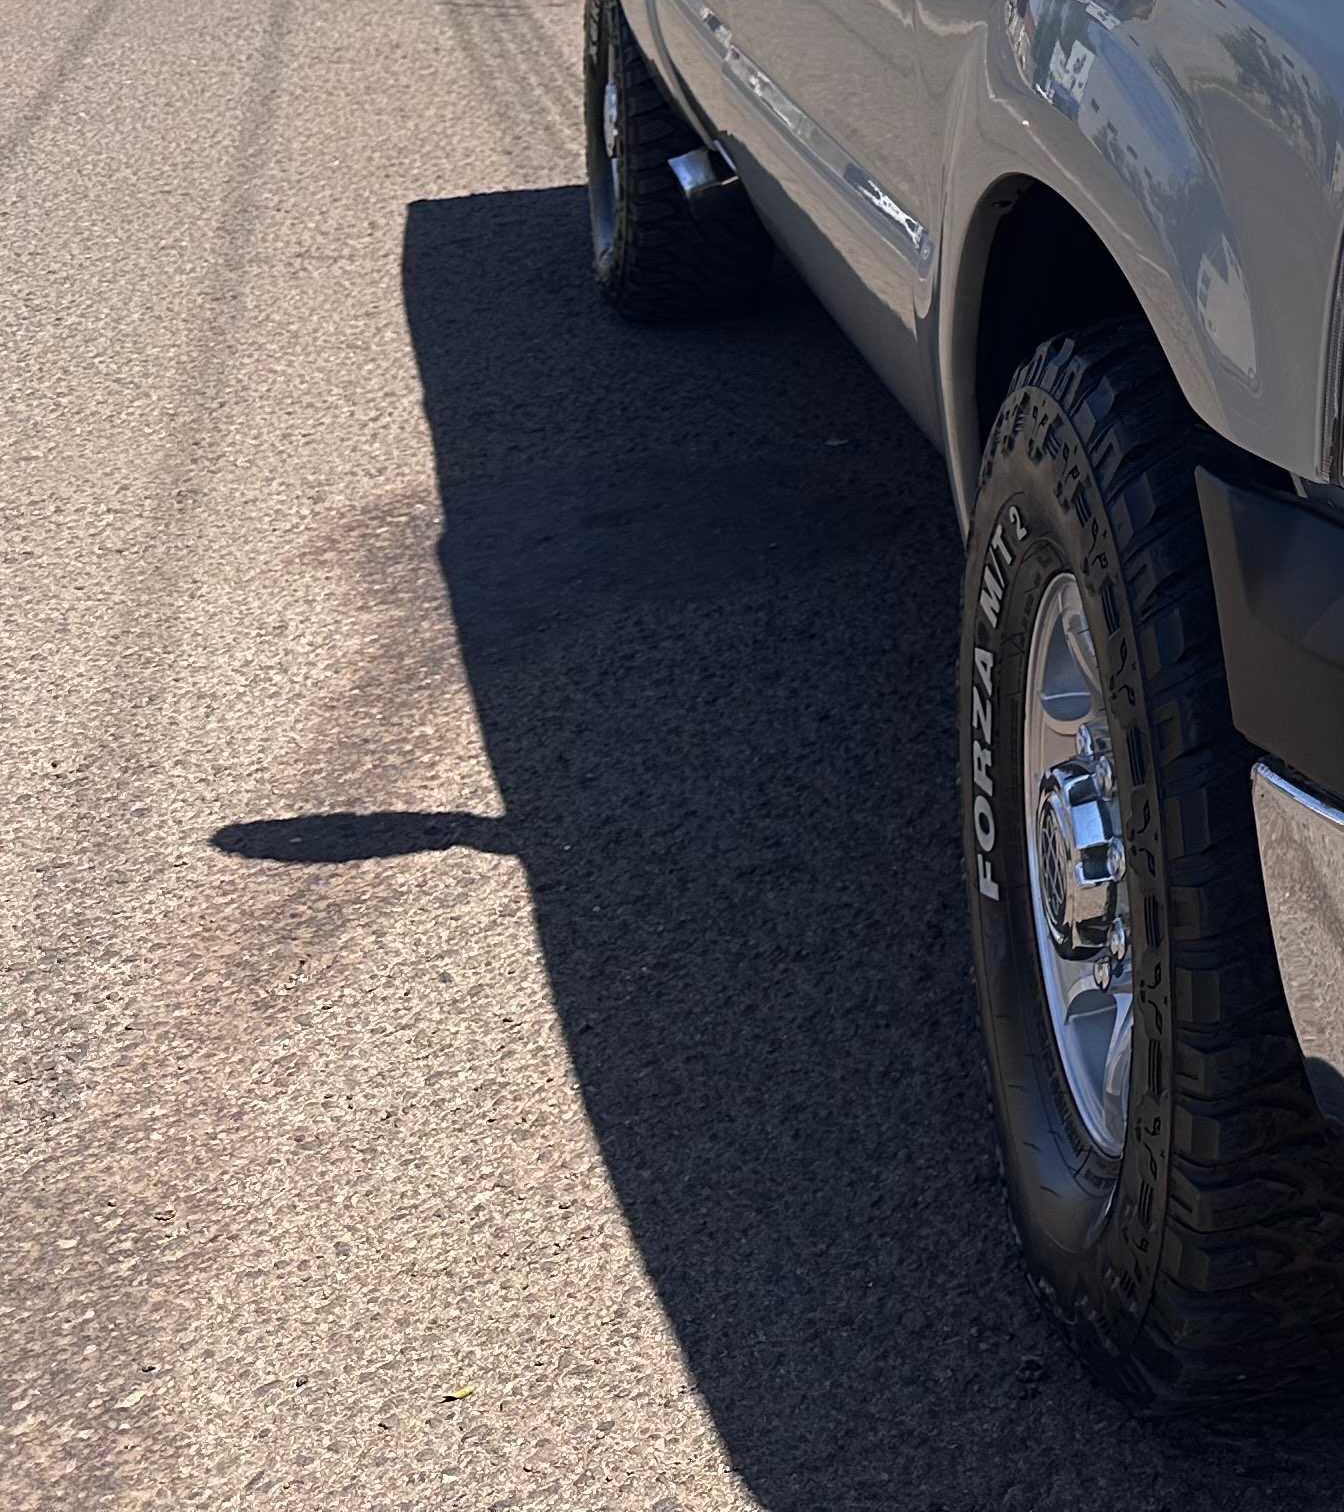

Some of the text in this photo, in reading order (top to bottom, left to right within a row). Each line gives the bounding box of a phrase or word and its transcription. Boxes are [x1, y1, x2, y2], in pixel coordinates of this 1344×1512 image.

[972, 505, 1028, 901] FORZA M/T 2
